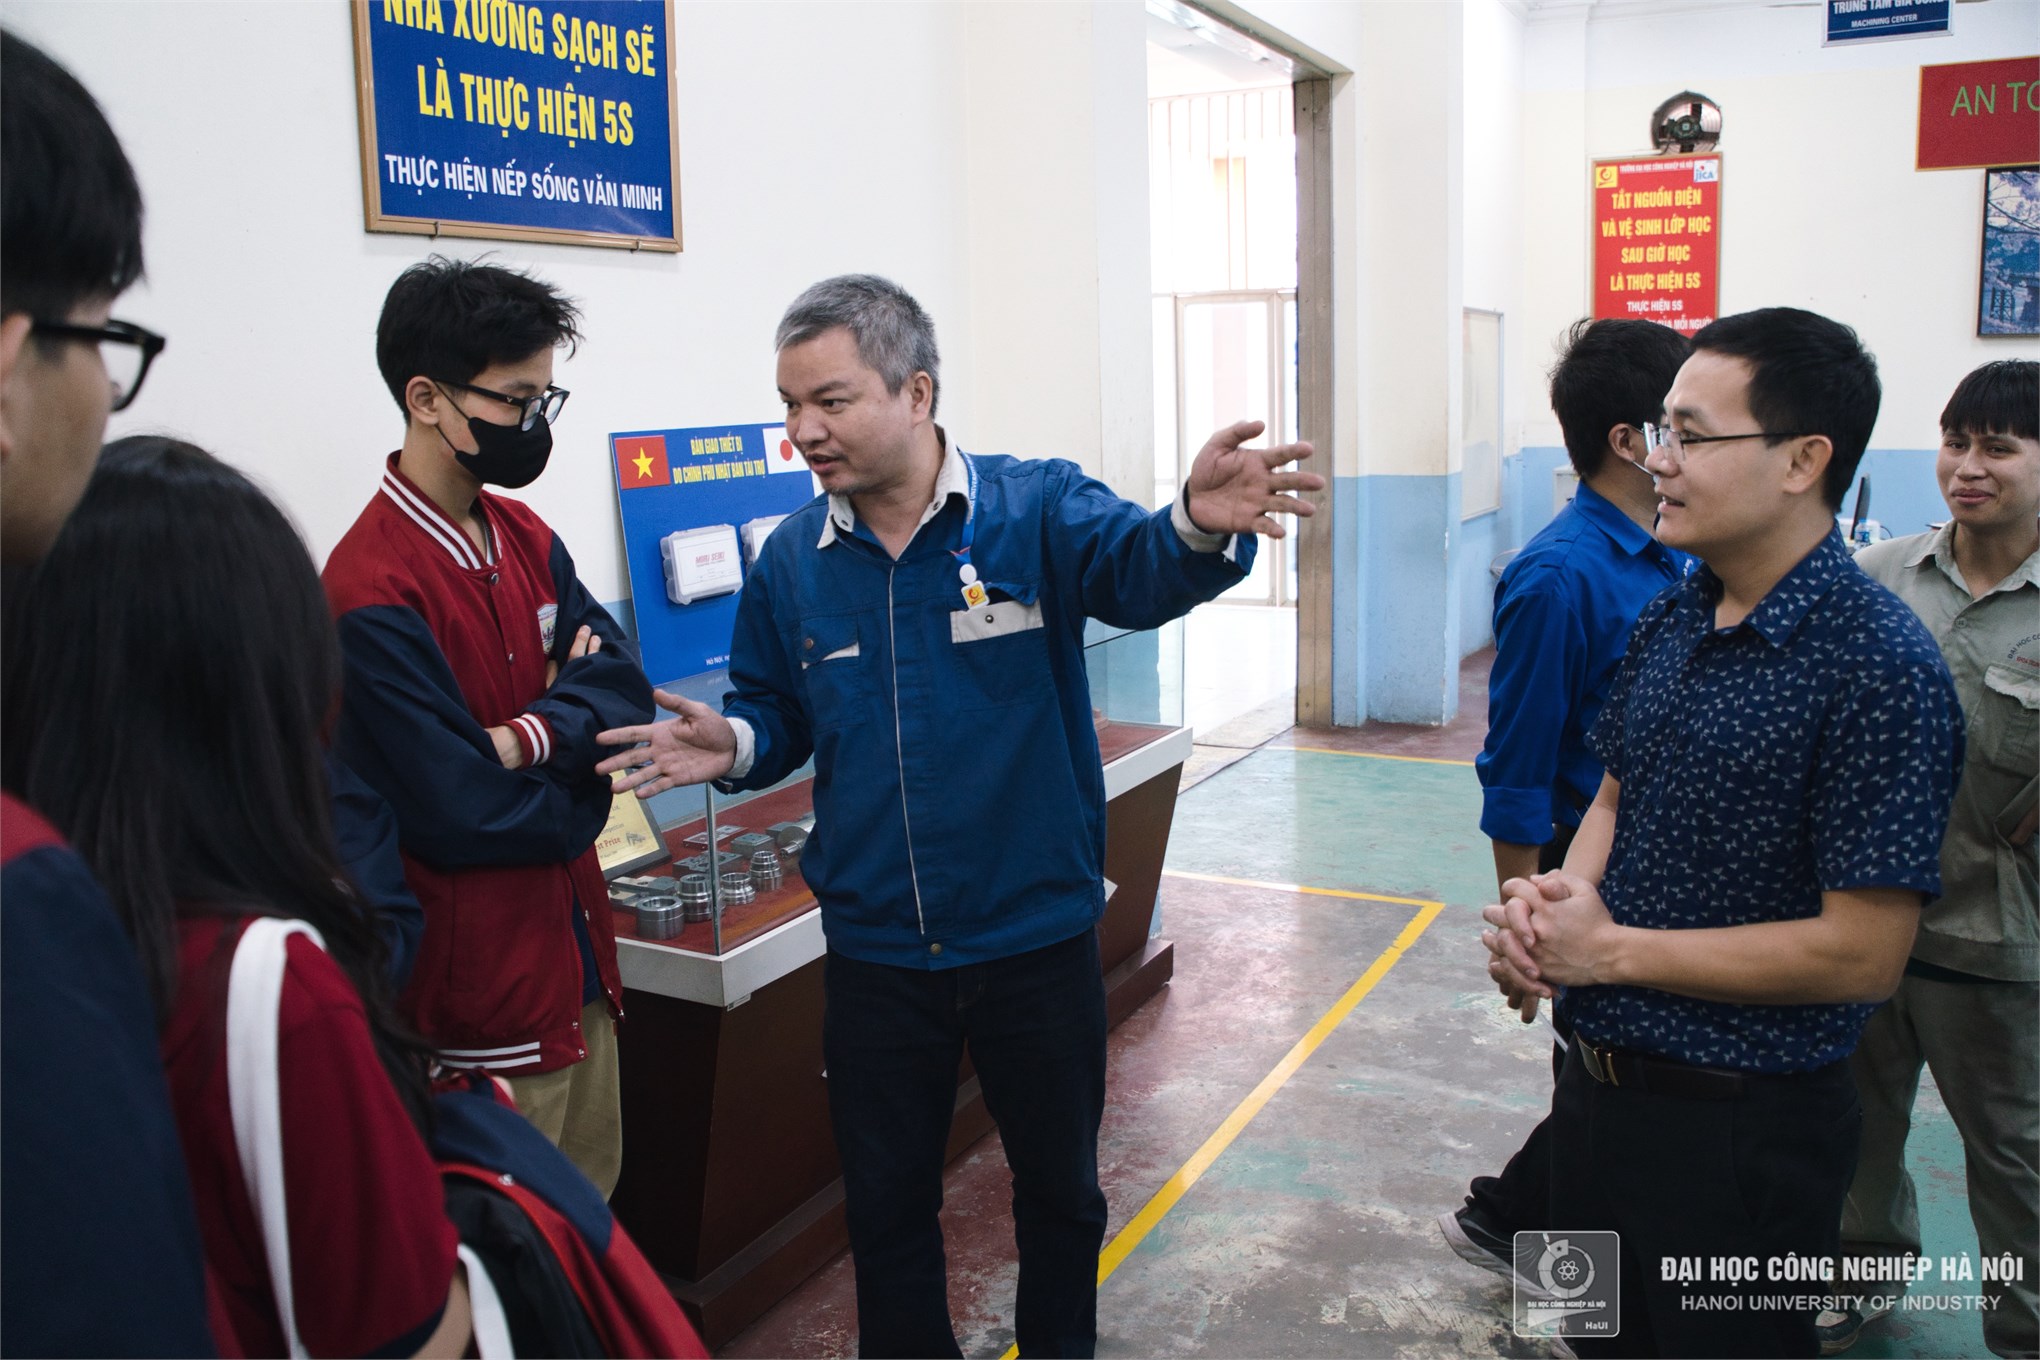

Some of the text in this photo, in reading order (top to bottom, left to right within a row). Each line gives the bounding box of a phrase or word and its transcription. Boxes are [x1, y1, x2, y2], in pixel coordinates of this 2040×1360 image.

[1833, 0, 1867, 15] TRUNG
[1851, 13, 1918, 28] MACHINING CENTER
[552, 13, 618, 73] SẠCH
[625, 24, 656, 77] SẼ
[417, 57, 634, 148] LÀ THỰC HIỆN 5S
[1951, 84, 1996, 117] AN
[384, 154, 663, 211] THỰC HIỆN NẾP SỐNG VĂN MINH
[1675, 185, 1702, 209] ĐIỆN
[1602, 213, 1712, 240] VÀ VỆ SINH LỚP HỌC
[1621, 247, 1644, 264] SAU
[1667, 244, 1691, 265] HỌC
[1610, 269, 1701, 294] LÀ THỰC HIỆN 5S
[1626, 297, 1683, 315] THỰC HIỆN 5S
